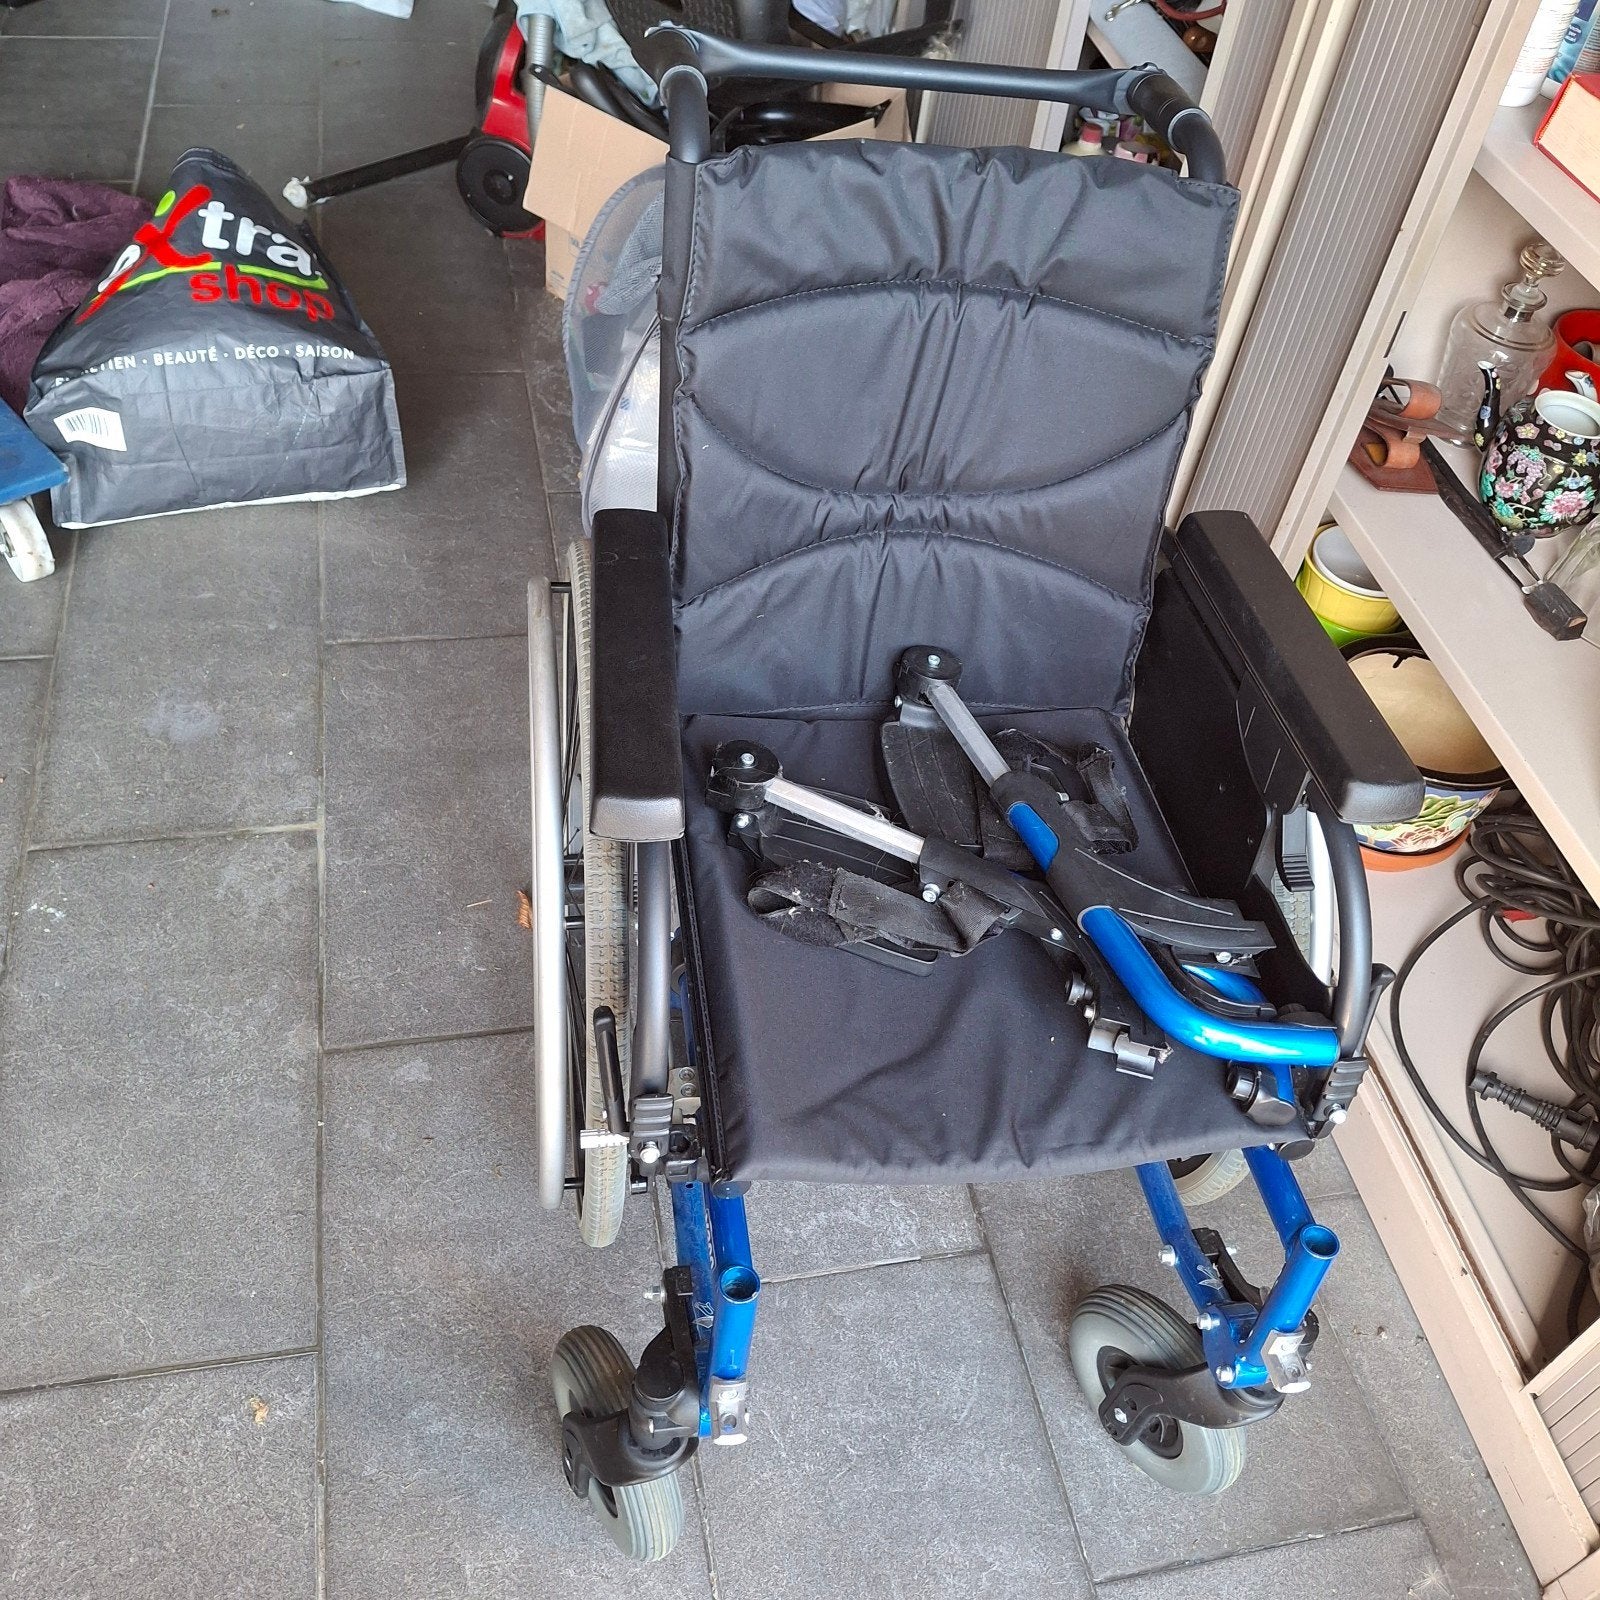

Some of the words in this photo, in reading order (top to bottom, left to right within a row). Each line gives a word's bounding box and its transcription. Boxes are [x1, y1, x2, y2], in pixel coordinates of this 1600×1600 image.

[189, 264, 335, 322] shop
[153, 346, 218, 366] BEAUTÉ
[234, 344, 279, 360] DÉCO
[295, 344, 355, 361] SAISON
